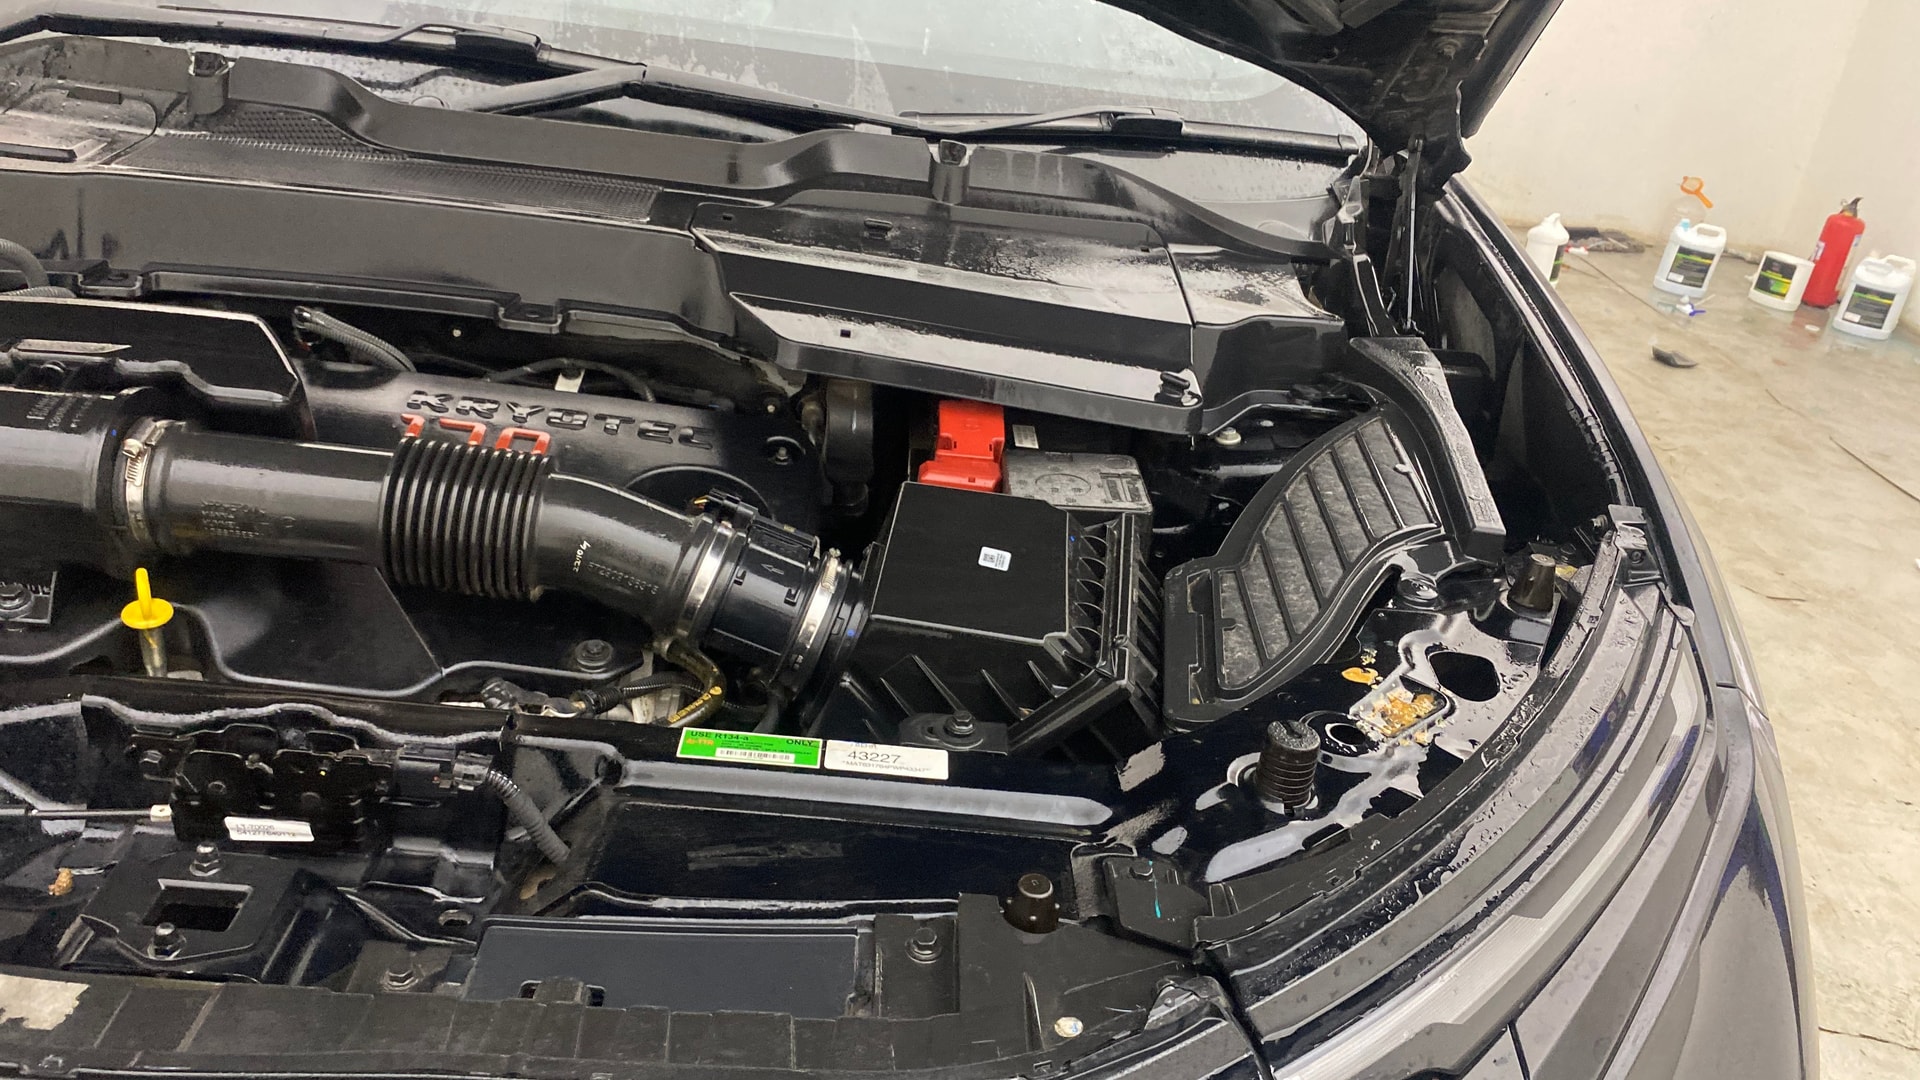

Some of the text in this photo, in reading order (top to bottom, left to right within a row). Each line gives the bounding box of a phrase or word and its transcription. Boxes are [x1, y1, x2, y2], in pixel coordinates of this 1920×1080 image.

[406, 389, 715, 450] KRYOTEC
[690, 730, 813, 746] USE R134-a ONLY
[847, 750, 902, 764] 43227
